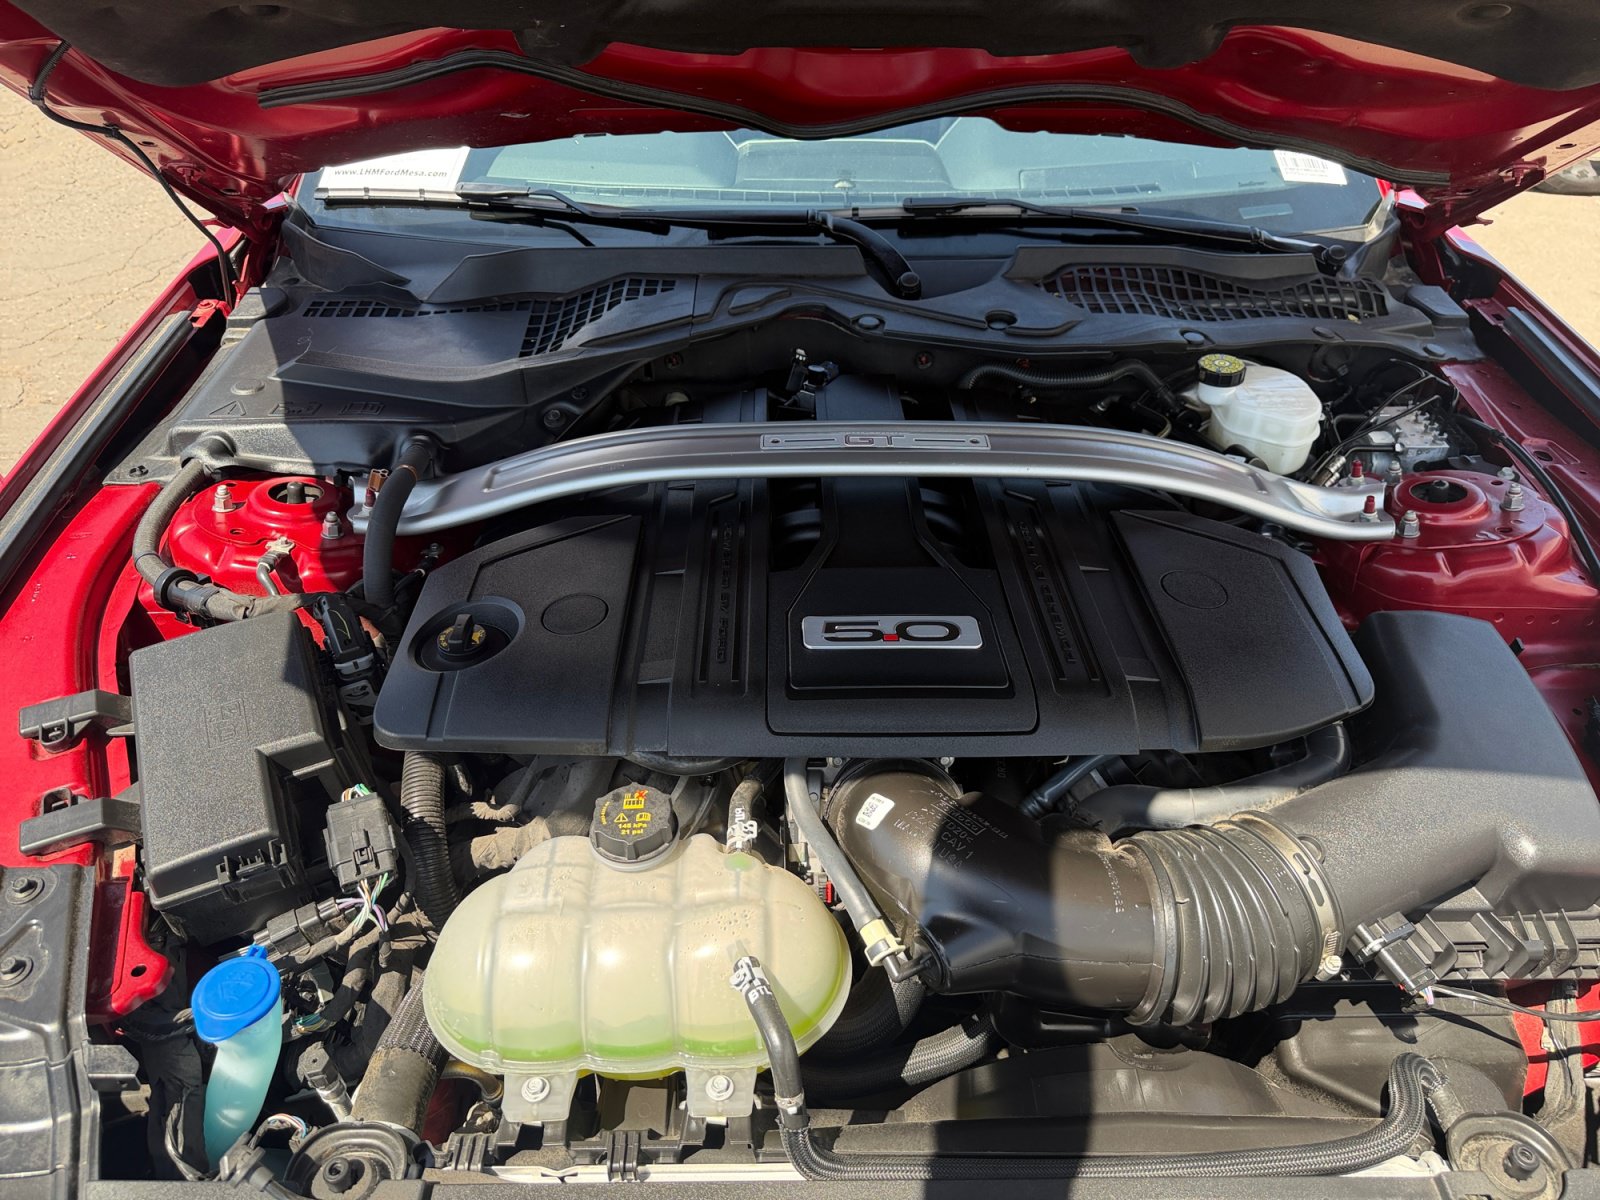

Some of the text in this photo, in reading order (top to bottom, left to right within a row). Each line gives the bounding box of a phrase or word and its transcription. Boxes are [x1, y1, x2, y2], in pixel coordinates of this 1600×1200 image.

[334, 168, 448, 178] www.LHMFordMesa.com
[844, 433, 905, 447] GT
[821, 620, 961, 642] 5.0
[940, 831, 967, 852] CAV
